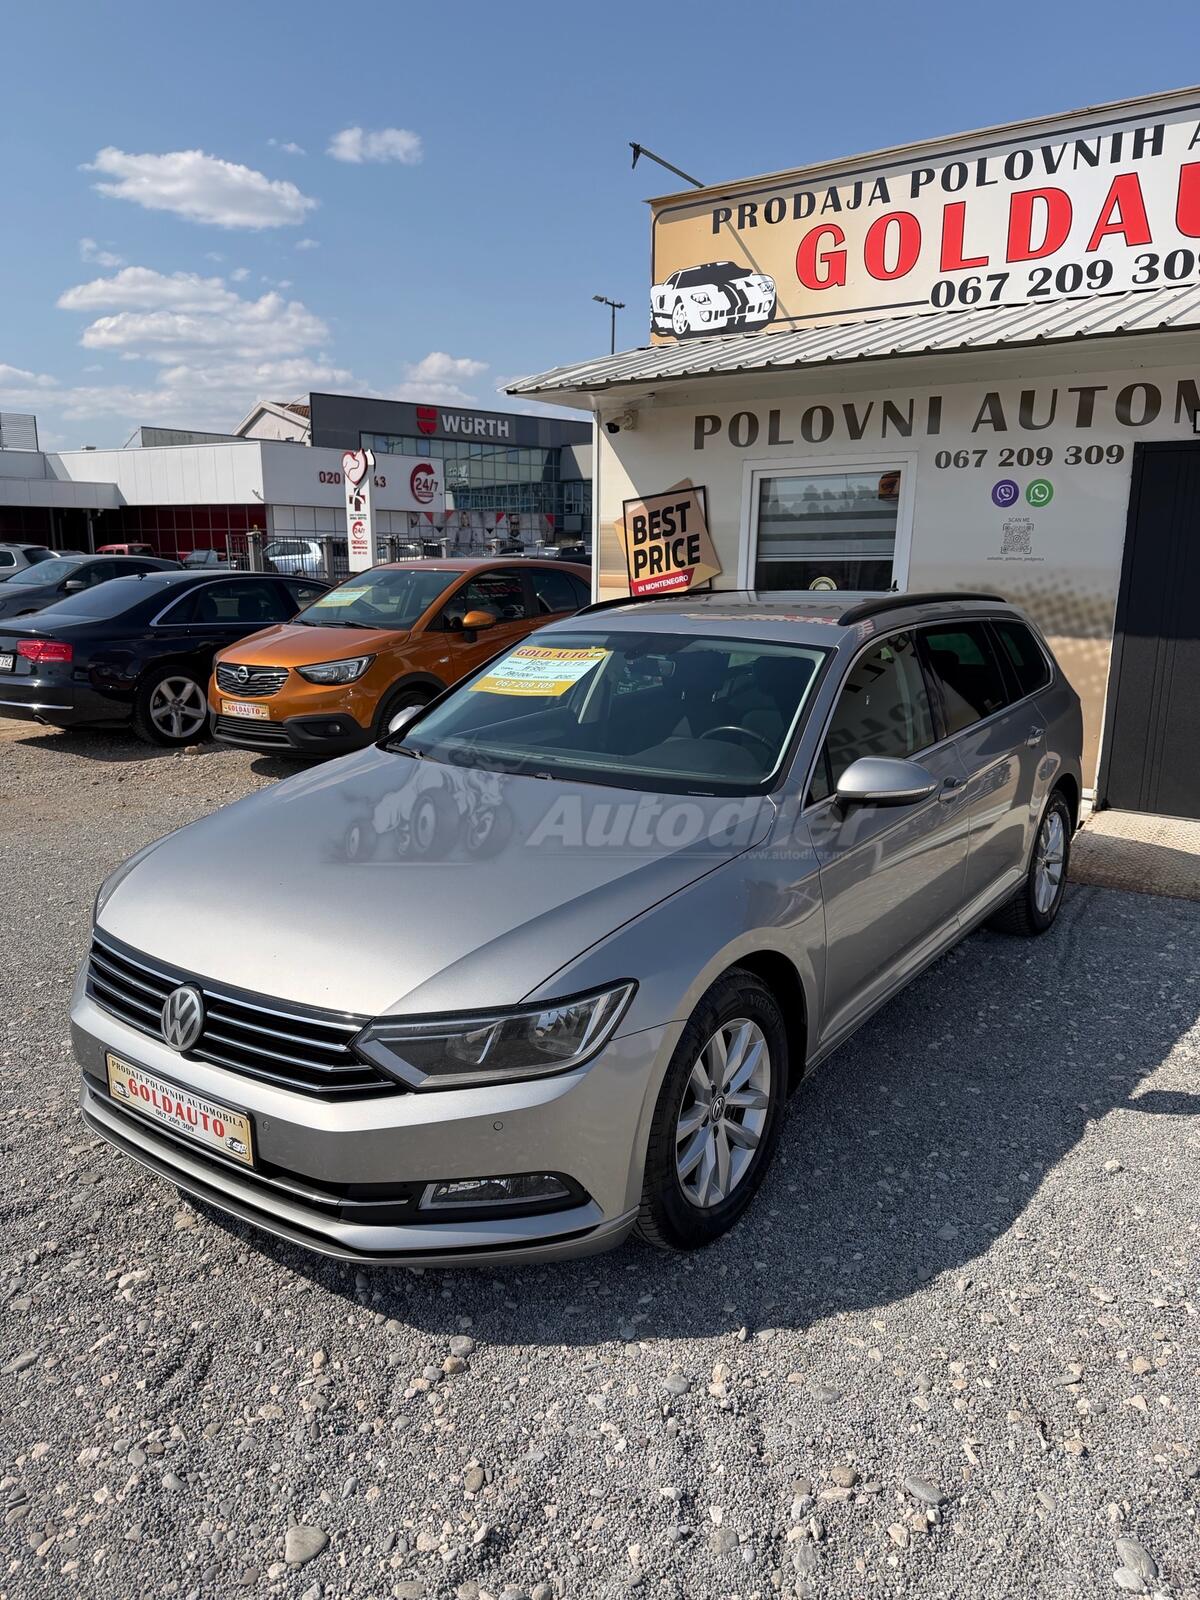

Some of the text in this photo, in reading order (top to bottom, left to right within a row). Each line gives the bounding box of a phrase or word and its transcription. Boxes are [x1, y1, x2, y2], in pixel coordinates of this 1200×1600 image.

[711, 176, 891, 235] PRODAJA
[910, 123, 1165, 199] POLOVNIH
[930, 249, 1200, 308] 067 209 30
[693, 395, 943, 450] POLOVNI
[319, 471, 341, 485] 020
[934, 444, 1125, 469] 067 209 309
[415, 477, 439, 492] 24/7
[632, 501, 691, 546] BEST
[633, 533, 701, 579] PRICE
[637, 574, 689, 593] IN MONTENEGRO
[516, 649, 589, 659] GOLD AUTO
[111, 1060, 244, 1129] PRODAJA POLOVNIH AUTOMOBILA
[127, 1078, 225, 1138] GOLDAUTO
